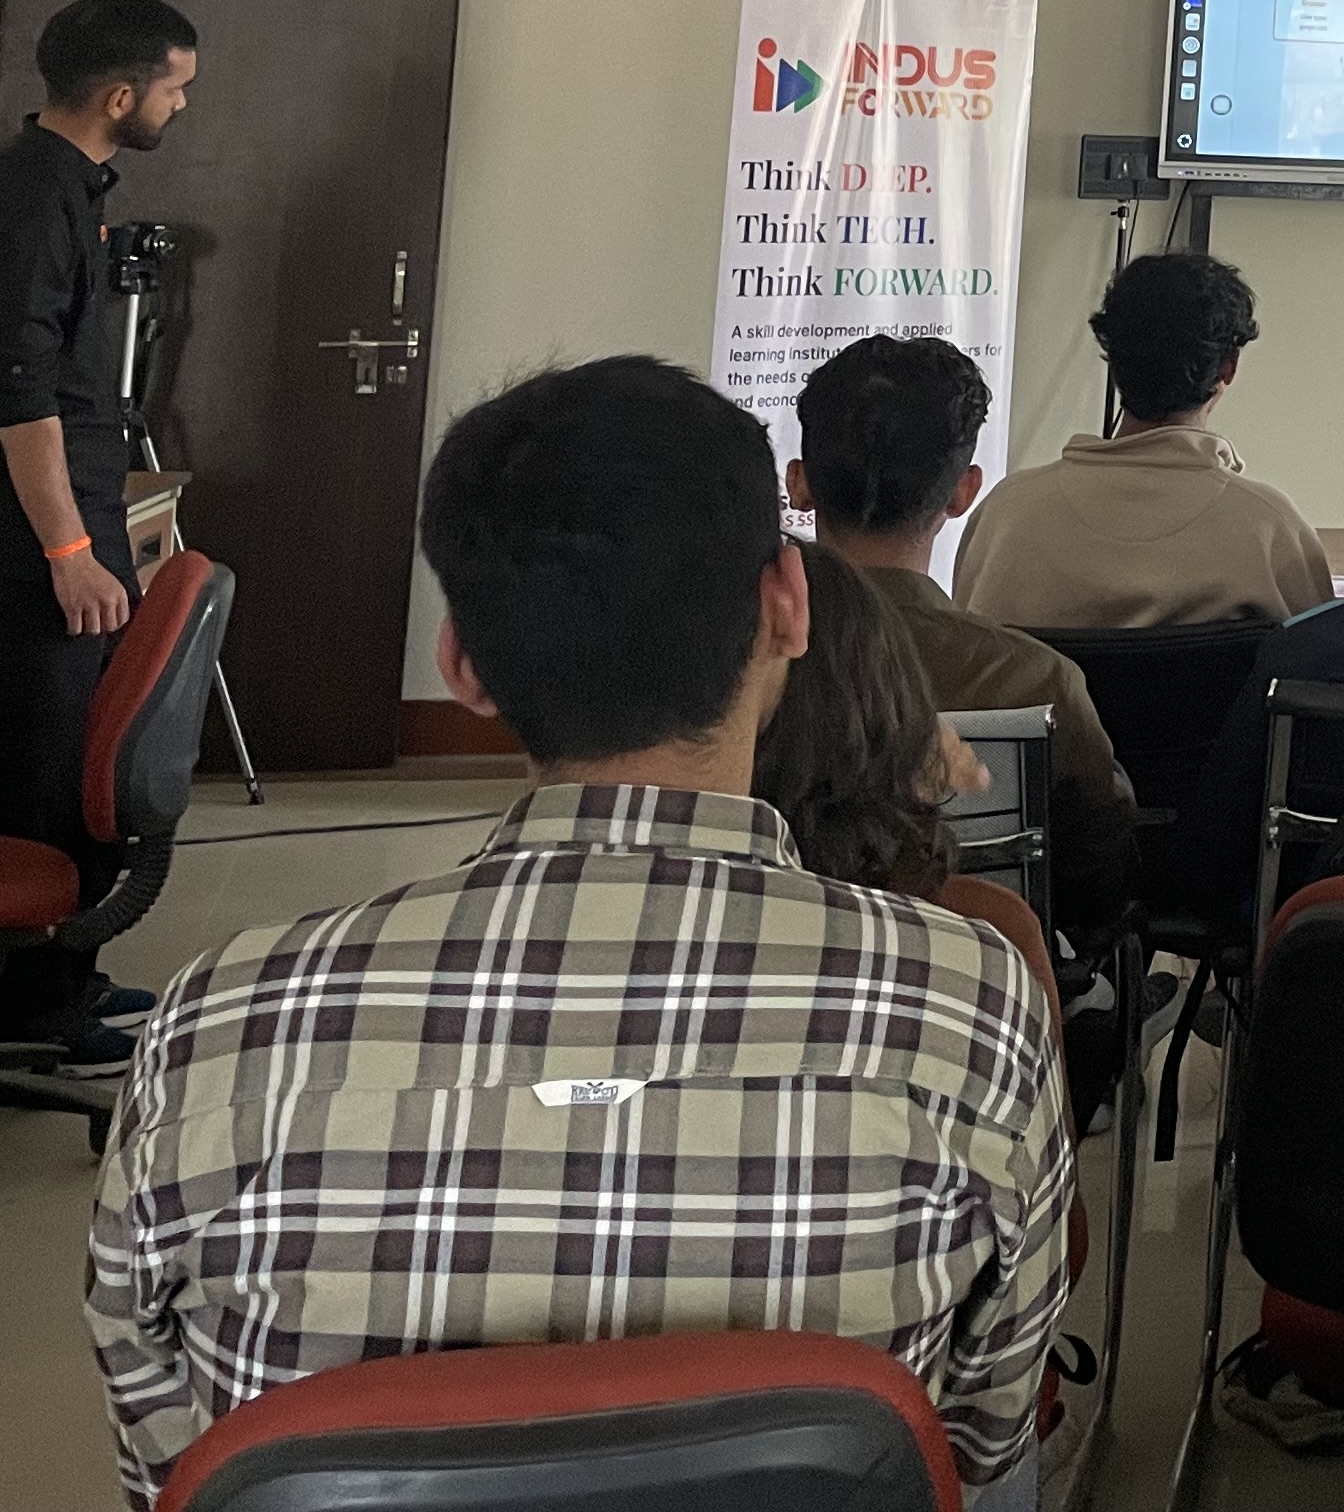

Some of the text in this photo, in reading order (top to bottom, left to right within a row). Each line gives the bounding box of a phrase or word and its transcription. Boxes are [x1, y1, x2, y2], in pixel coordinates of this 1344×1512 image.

[844, 41, 996, 89] INDUS
[741, 159, 932, 194] Think DEP.
[736, 213, 935, 245] Think TECH.
[732, 265, 999, 297] Think FORWARD.
[731, 322, 953, 340] A skill development and applied
[729, 348, 785, 364] learning
[985, 343, 1002, 356] for
[727, 372, 752, 386] the
[756, 370, 797, 385] needs
[733, 394, 754, 409] nd
